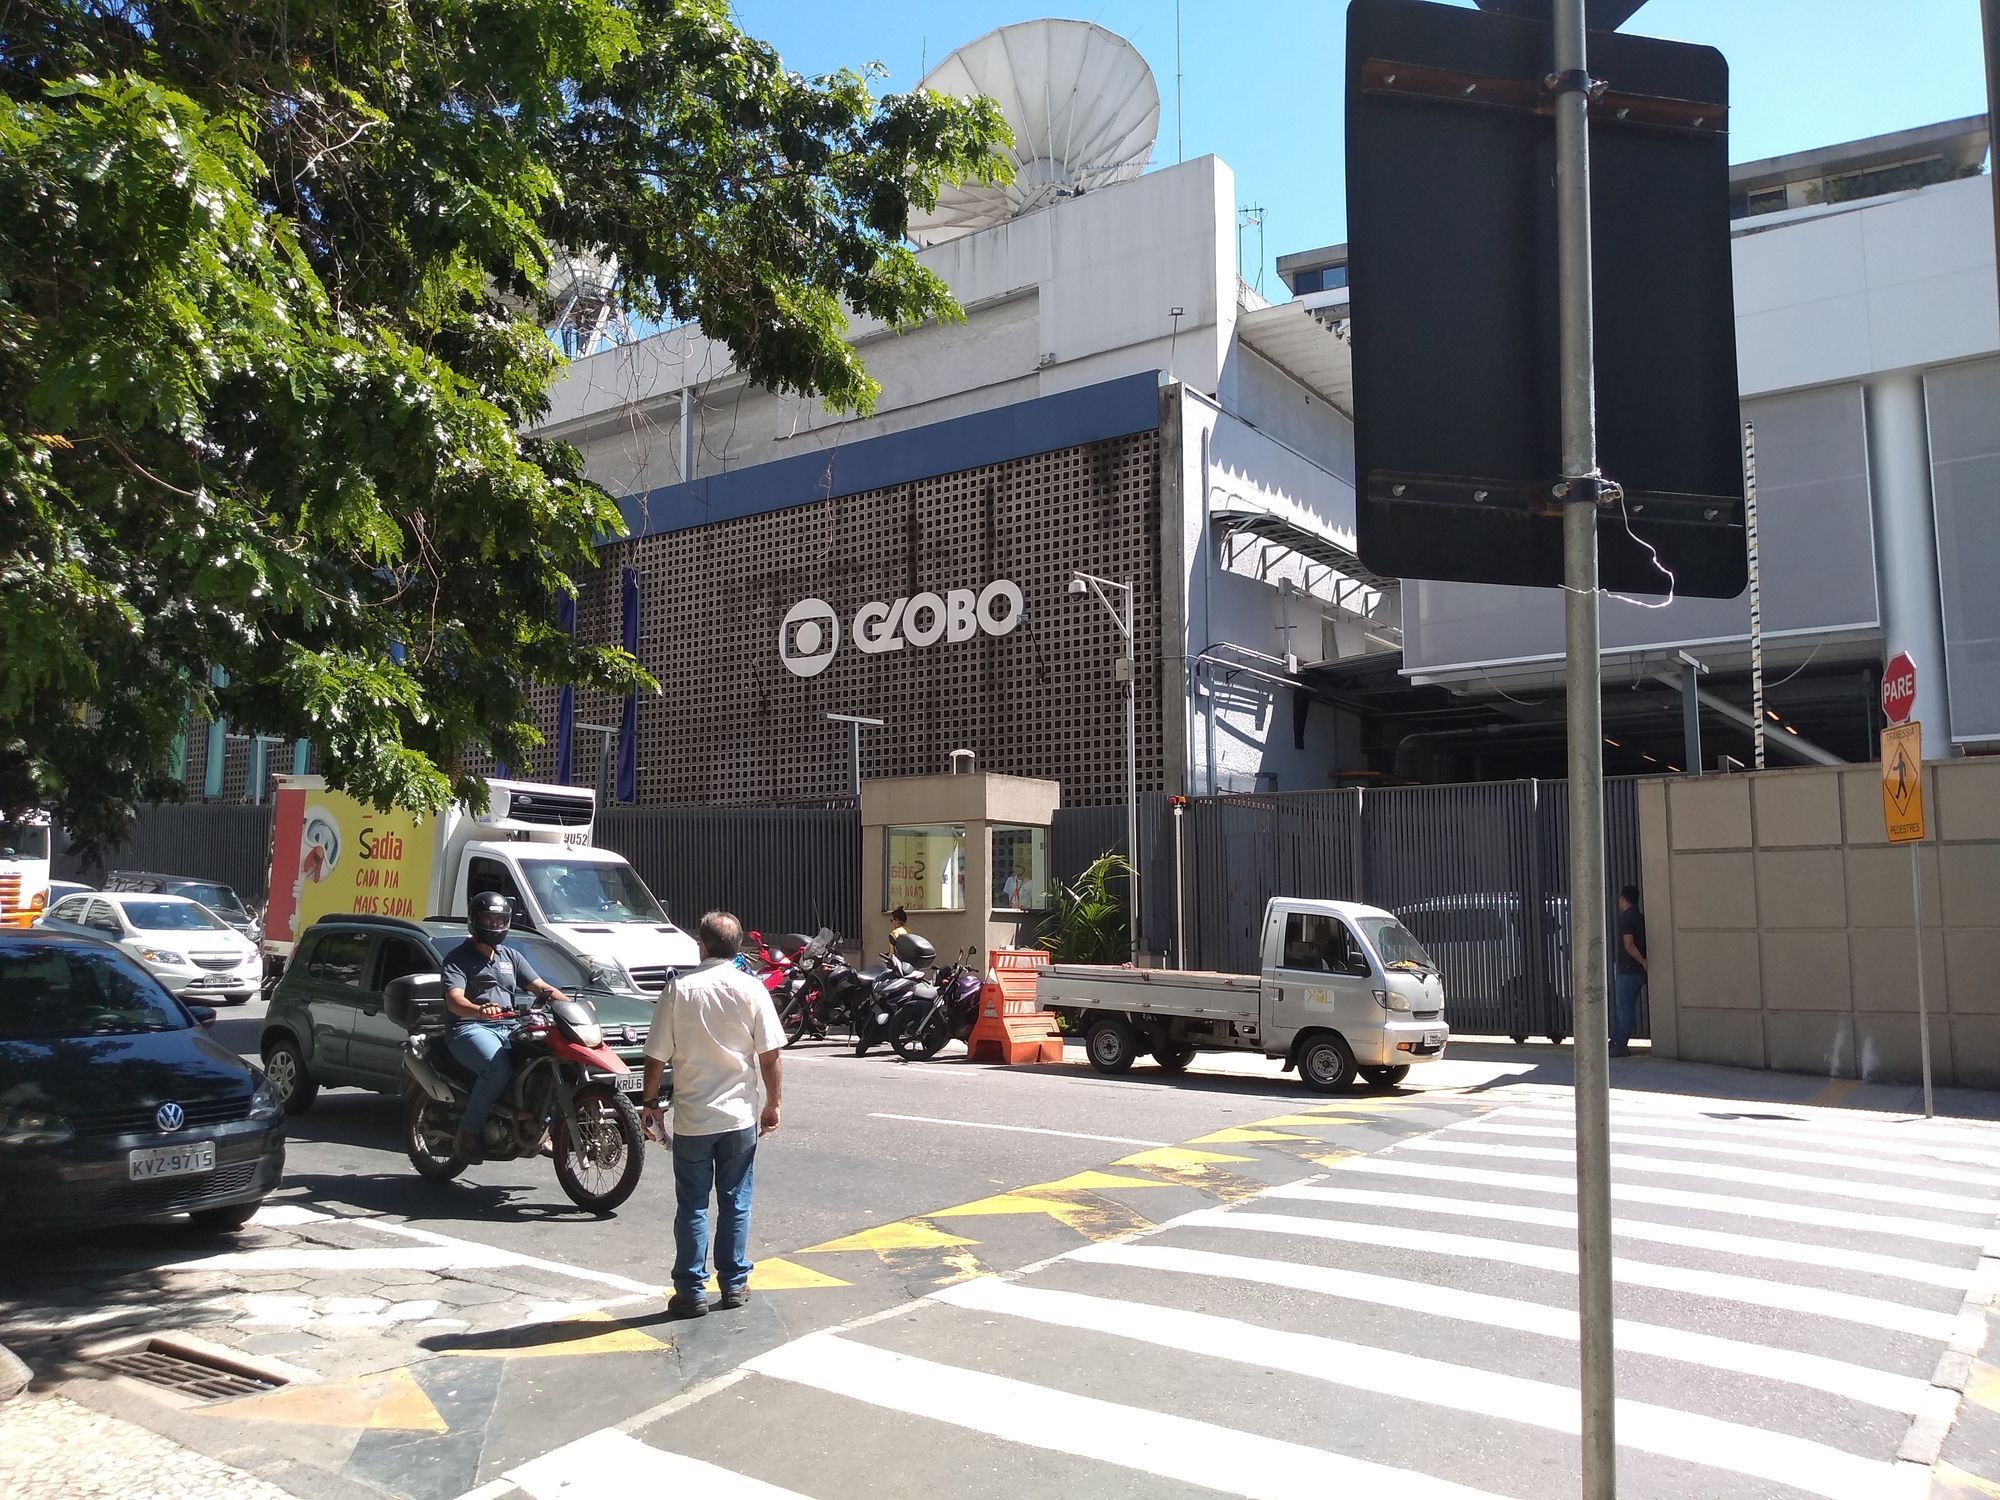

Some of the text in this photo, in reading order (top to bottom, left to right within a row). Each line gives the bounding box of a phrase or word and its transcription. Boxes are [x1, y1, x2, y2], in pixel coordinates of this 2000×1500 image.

[853, 579, 1024, 654] GLOBO
[1883, 673, 1913, 704] PARE
[563, 833, 588, 846] 9052
[1890, 822, 1920, 835] PEDESTRES
[359, 827, 403, 860] Sadia
[356, 868, 399, 889] CADA DIA
[353, 895, 415, 918] MAIS SADIA.
[616, 1078, 643, 1090] KRU-6
[133, 1151, 213, 1176] KVZ-9715
